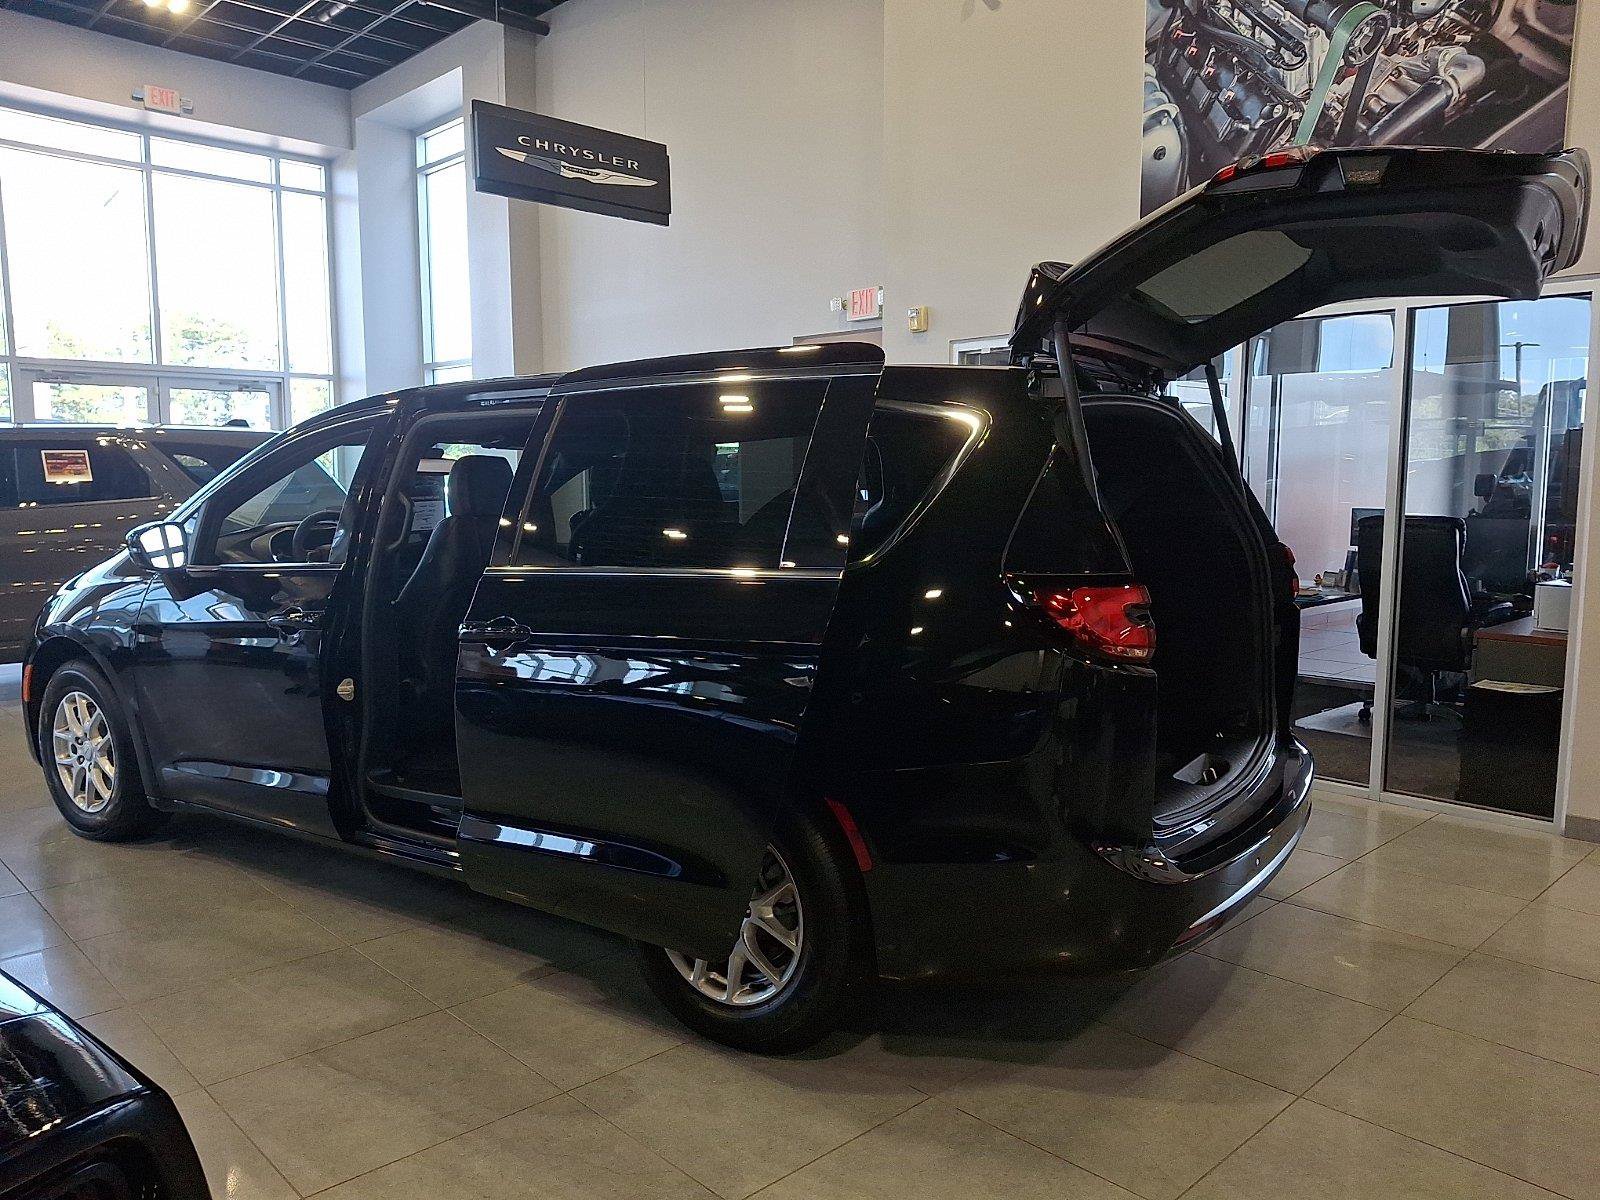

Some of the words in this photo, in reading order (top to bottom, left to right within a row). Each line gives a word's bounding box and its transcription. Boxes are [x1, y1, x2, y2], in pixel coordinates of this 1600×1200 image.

[151, 86, 175, 108] EXIT
[517, 135, 640, 171] CHRYSLER
[851, 288, 875, 319] EXIT
